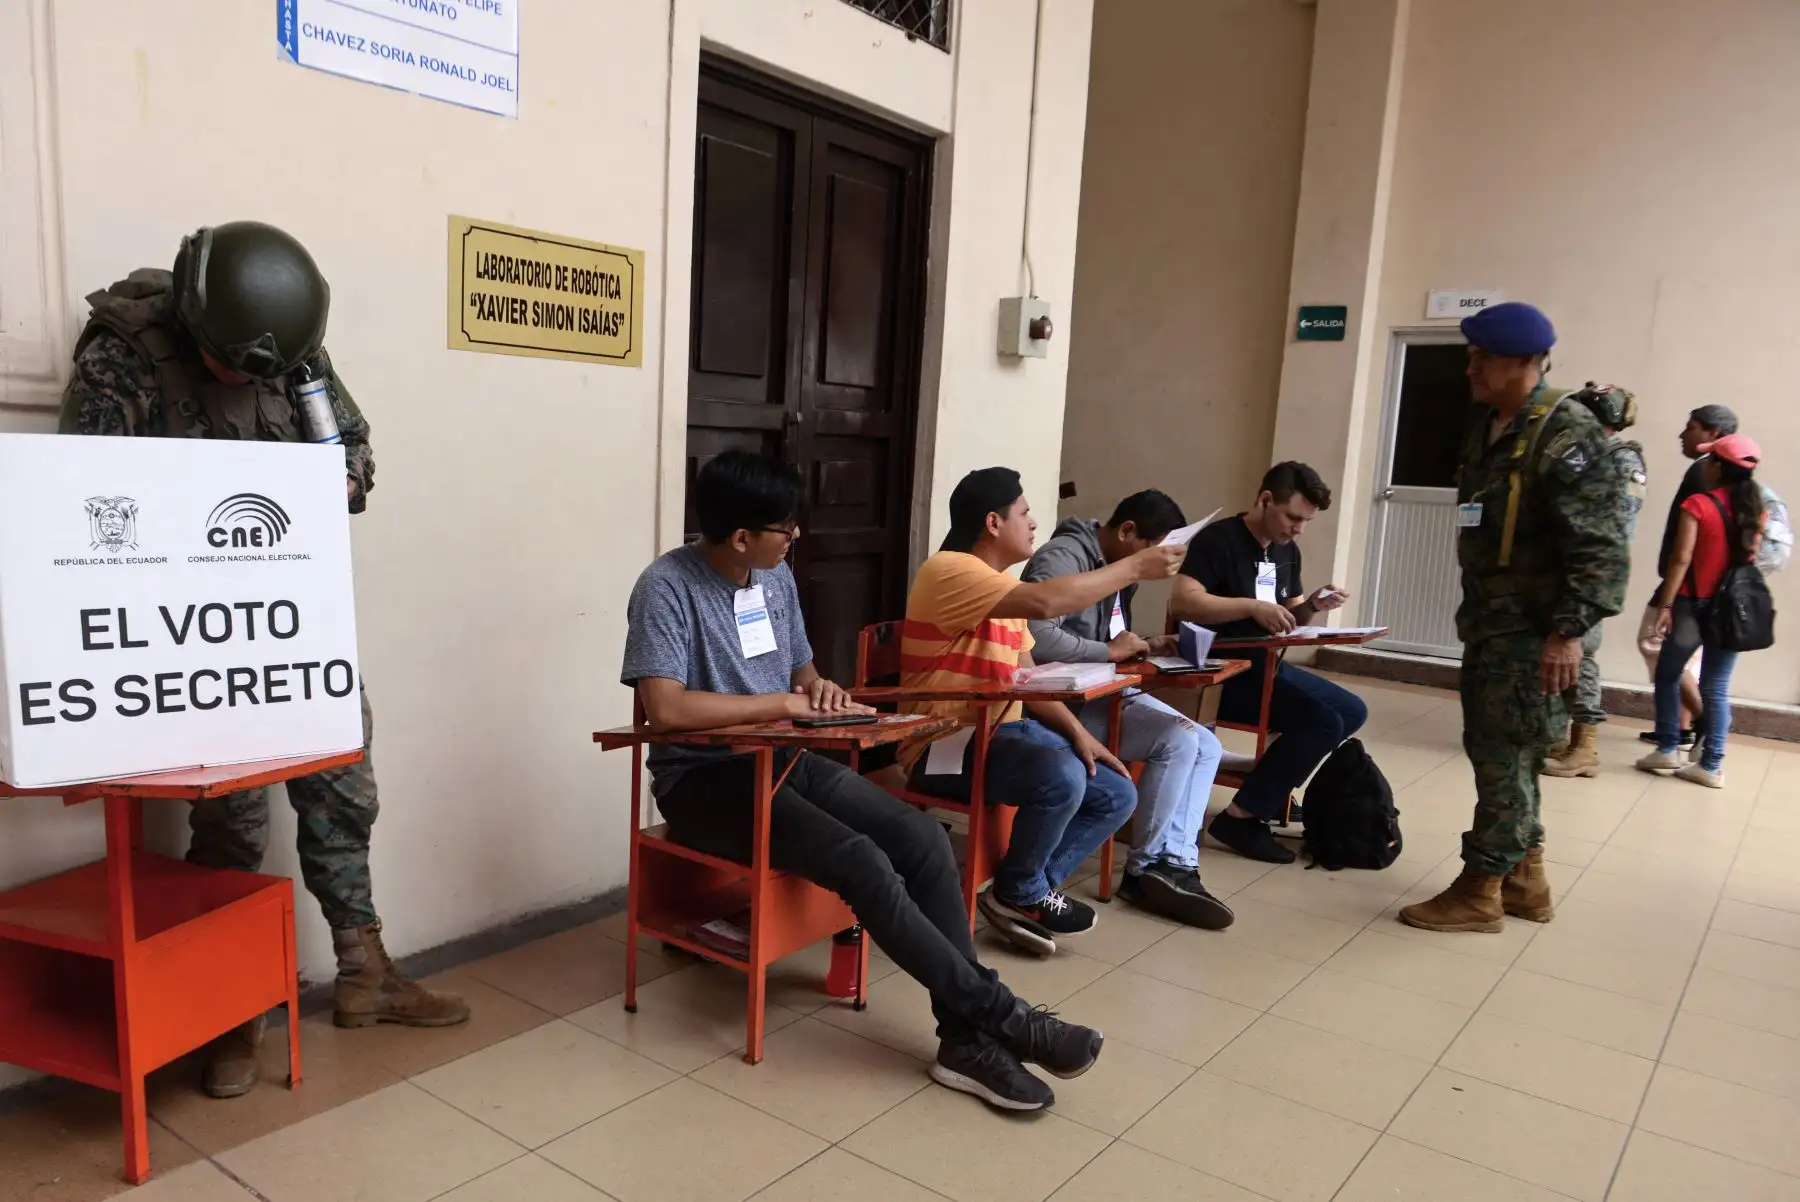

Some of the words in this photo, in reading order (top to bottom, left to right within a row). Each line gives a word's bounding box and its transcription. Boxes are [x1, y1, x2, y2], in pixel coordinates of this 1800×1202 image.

[457, 0, 502, 16] ELIPE
[302, 22, 366, 53] CHAVEZ
[370, 41, 415, 66] SORIA
[420, 54, 476, 82] RONALD
[480, 73, 514, 92] JOEL
[476, 250, 552, 289] LABORATORIO
[555, 264, 569, 292] DE
[571, 265, 621, 300] ROBÓTICA
[1459, 298, 1488, 308] DECE
[532, 300, 574, 332] SIMON
[1313, 319, 1345, 328] SALIDA
[53, 557, 105, 566] REPÚBLICA
[107, 557, 124, 565] DEL
[126, 556, 168, 565] ECUADOR
[187, 555, 226, 563] CONSEJO
[227, 554, 267, 562] NACIONAL
[268, 553, 312, 561] ELECTORAL
[80, 607, 149, 651] EL
[158, 599, 300, 646] VOTO
[19, 678, 97, 726] ES
[114, 659, 354, 718] SECRETO
